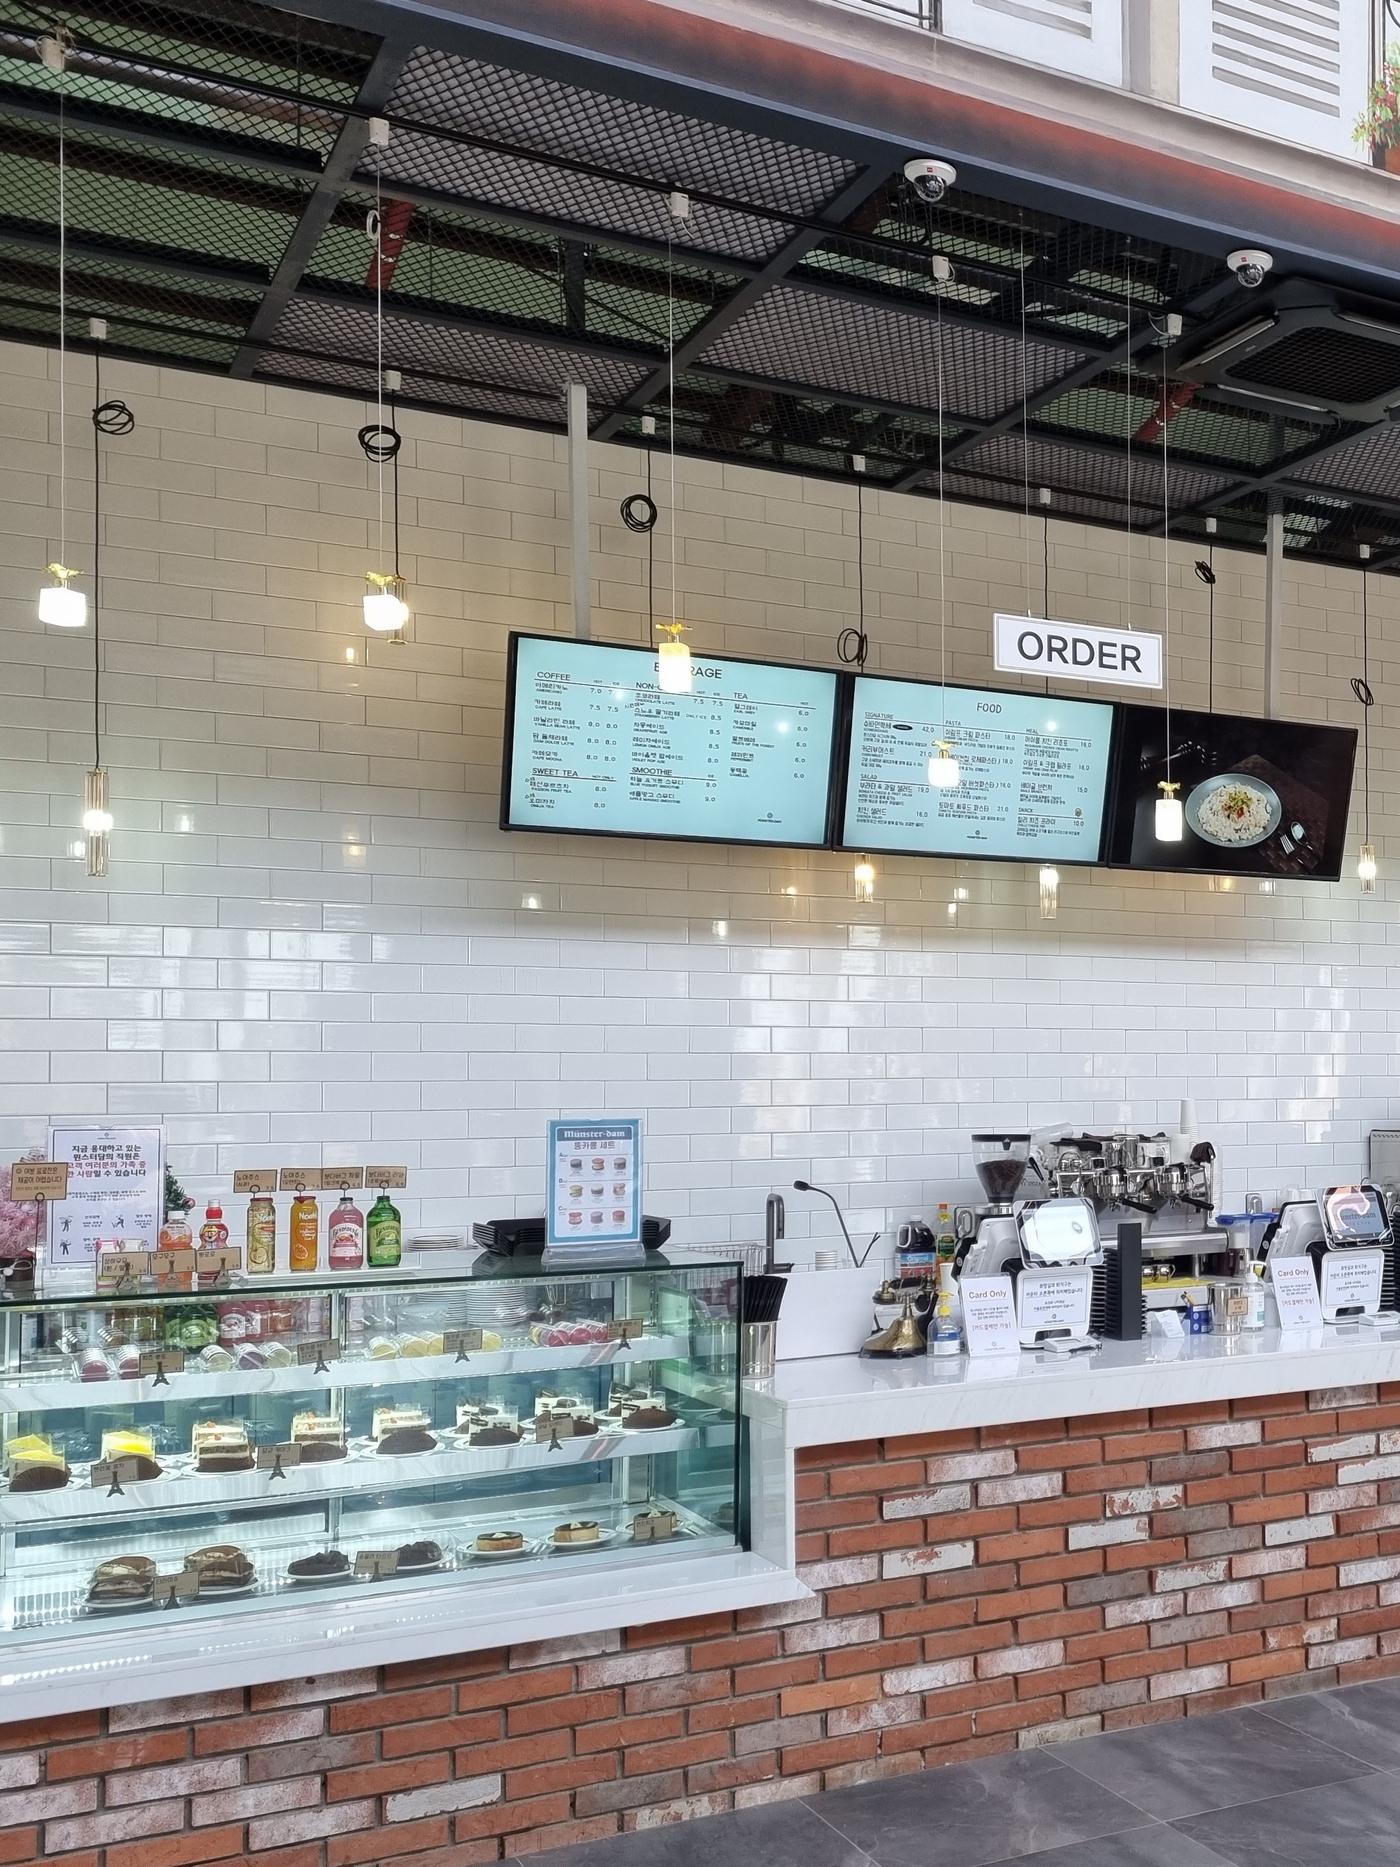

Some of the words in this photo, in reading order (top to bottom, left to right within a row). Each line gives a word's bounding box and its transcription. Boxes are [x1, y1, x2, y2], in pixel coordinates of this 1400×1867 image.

[1018, 631, 1142, 673] ORDER
[537, 671, 571, 681] COFFEE
[535, 682, 568, 691] 아메리카노
[733, 692, 749, 700] TEA
[734, 703, 758, 711] 얼그레이
[976, 702, 1002, 714] FOOD
[865, 711, 894, 720] SIGNATURE
[633, 721, 665, 730] 자몽에이드
[919, 750, 933, 758] 21.0
[532, 767, 559, 776] SWEET
[562, 769, 579, 777] TEA
[631, 766, 673, 776] SMOOTHIE
[665, 778, 684, 786] 스무디
[917, 786, 930, 794] 19.0
[563, 1130, 625, 1138] Münster-dam
[72, 1145, 88, 1153] 지금
[91, 1144, 123, 1153] 응대하고
[125, 1144, 142, 1152] 있는
[599, 1140, 616, 1149] 세트
[116, 1152, 140, 1161] 직원은
[68, 1161, 83, 1170] 고객
[85, 1161, 118, 1169] 여러분의
[120, 1161, 136, 1169] 가족
[138, 1160, 146, 1169] 중
[76, 1169, 101, 1178] 사람일
[103, 1169, 112, 1177] 수
[114, 1169, 146, 1177] 있습니다
[35, 1176, 62, 1184] 어렵습니다
[1294, 1269, 1309, 1277] Only
[968, 1291, 988, 1299] Card
[989, 1290, 1007, 1299] Only
